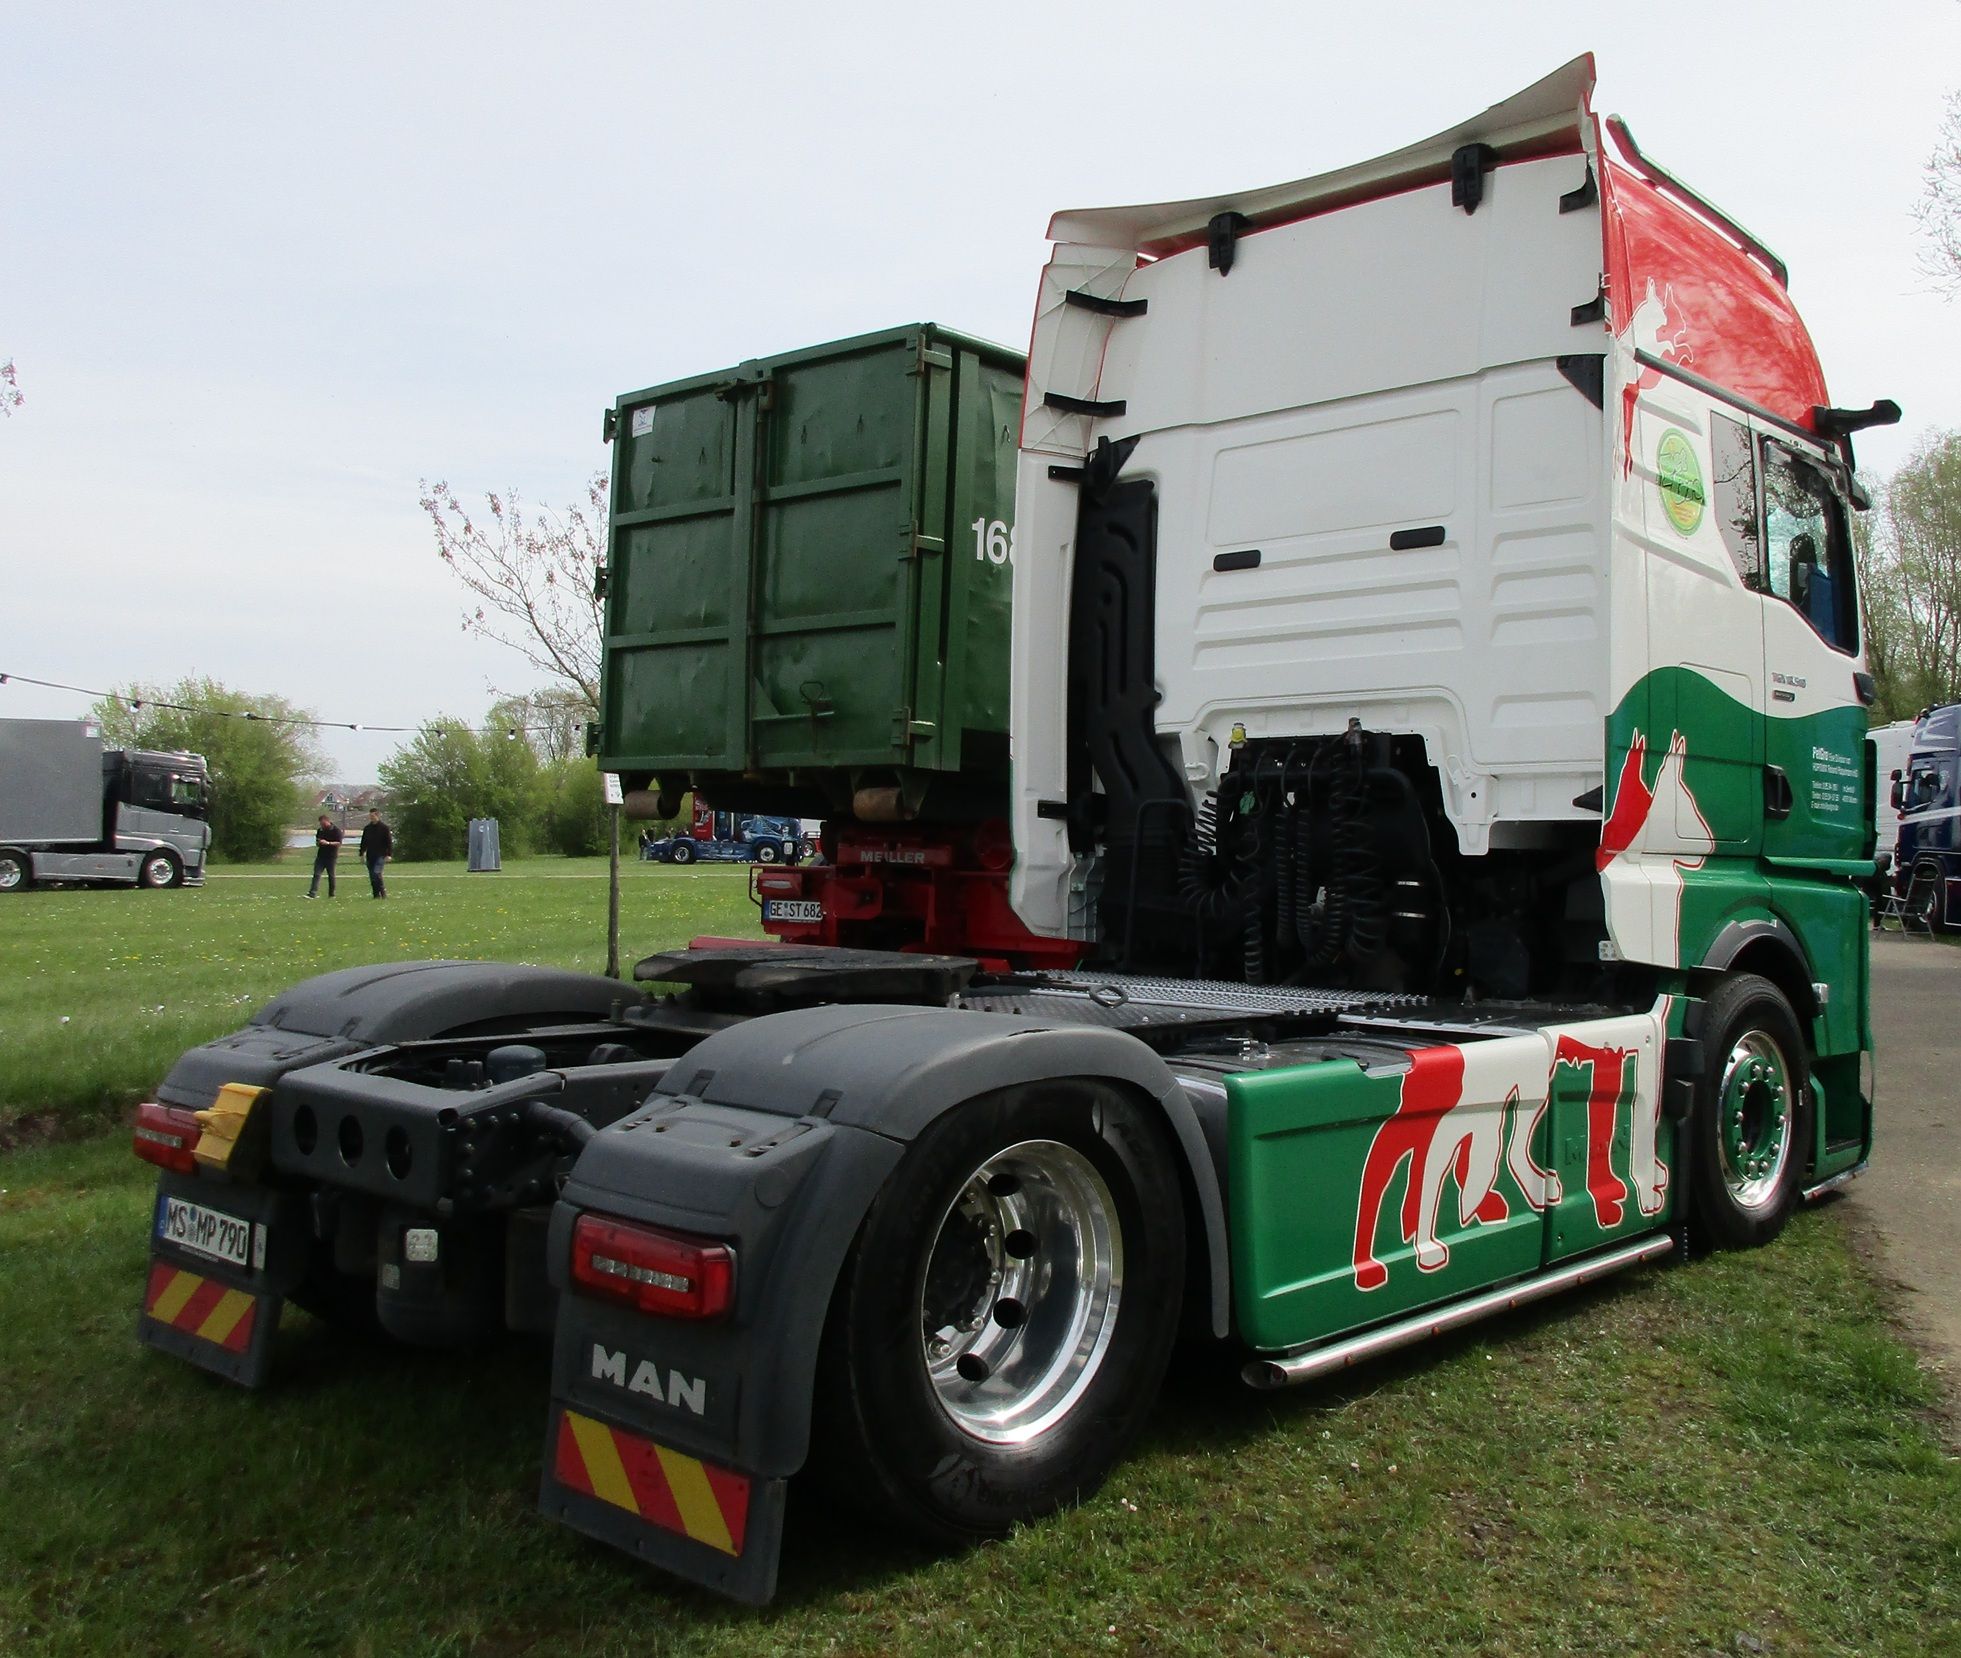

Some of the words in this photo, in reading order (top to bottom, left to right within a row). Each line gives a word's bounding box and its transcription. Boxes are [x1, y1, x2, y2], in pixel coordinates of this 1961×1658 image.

[770, 902, 782, 917] GE
[789, 903, 801, 917] ST
[804, 903, 823, 918] 682
[167, 1202, 188, 1238] MS
[196, 1211, 217, 1247] MP
[218, 1219, 247, 1259] 790
[592, 1343, 706, 1416] MAN
